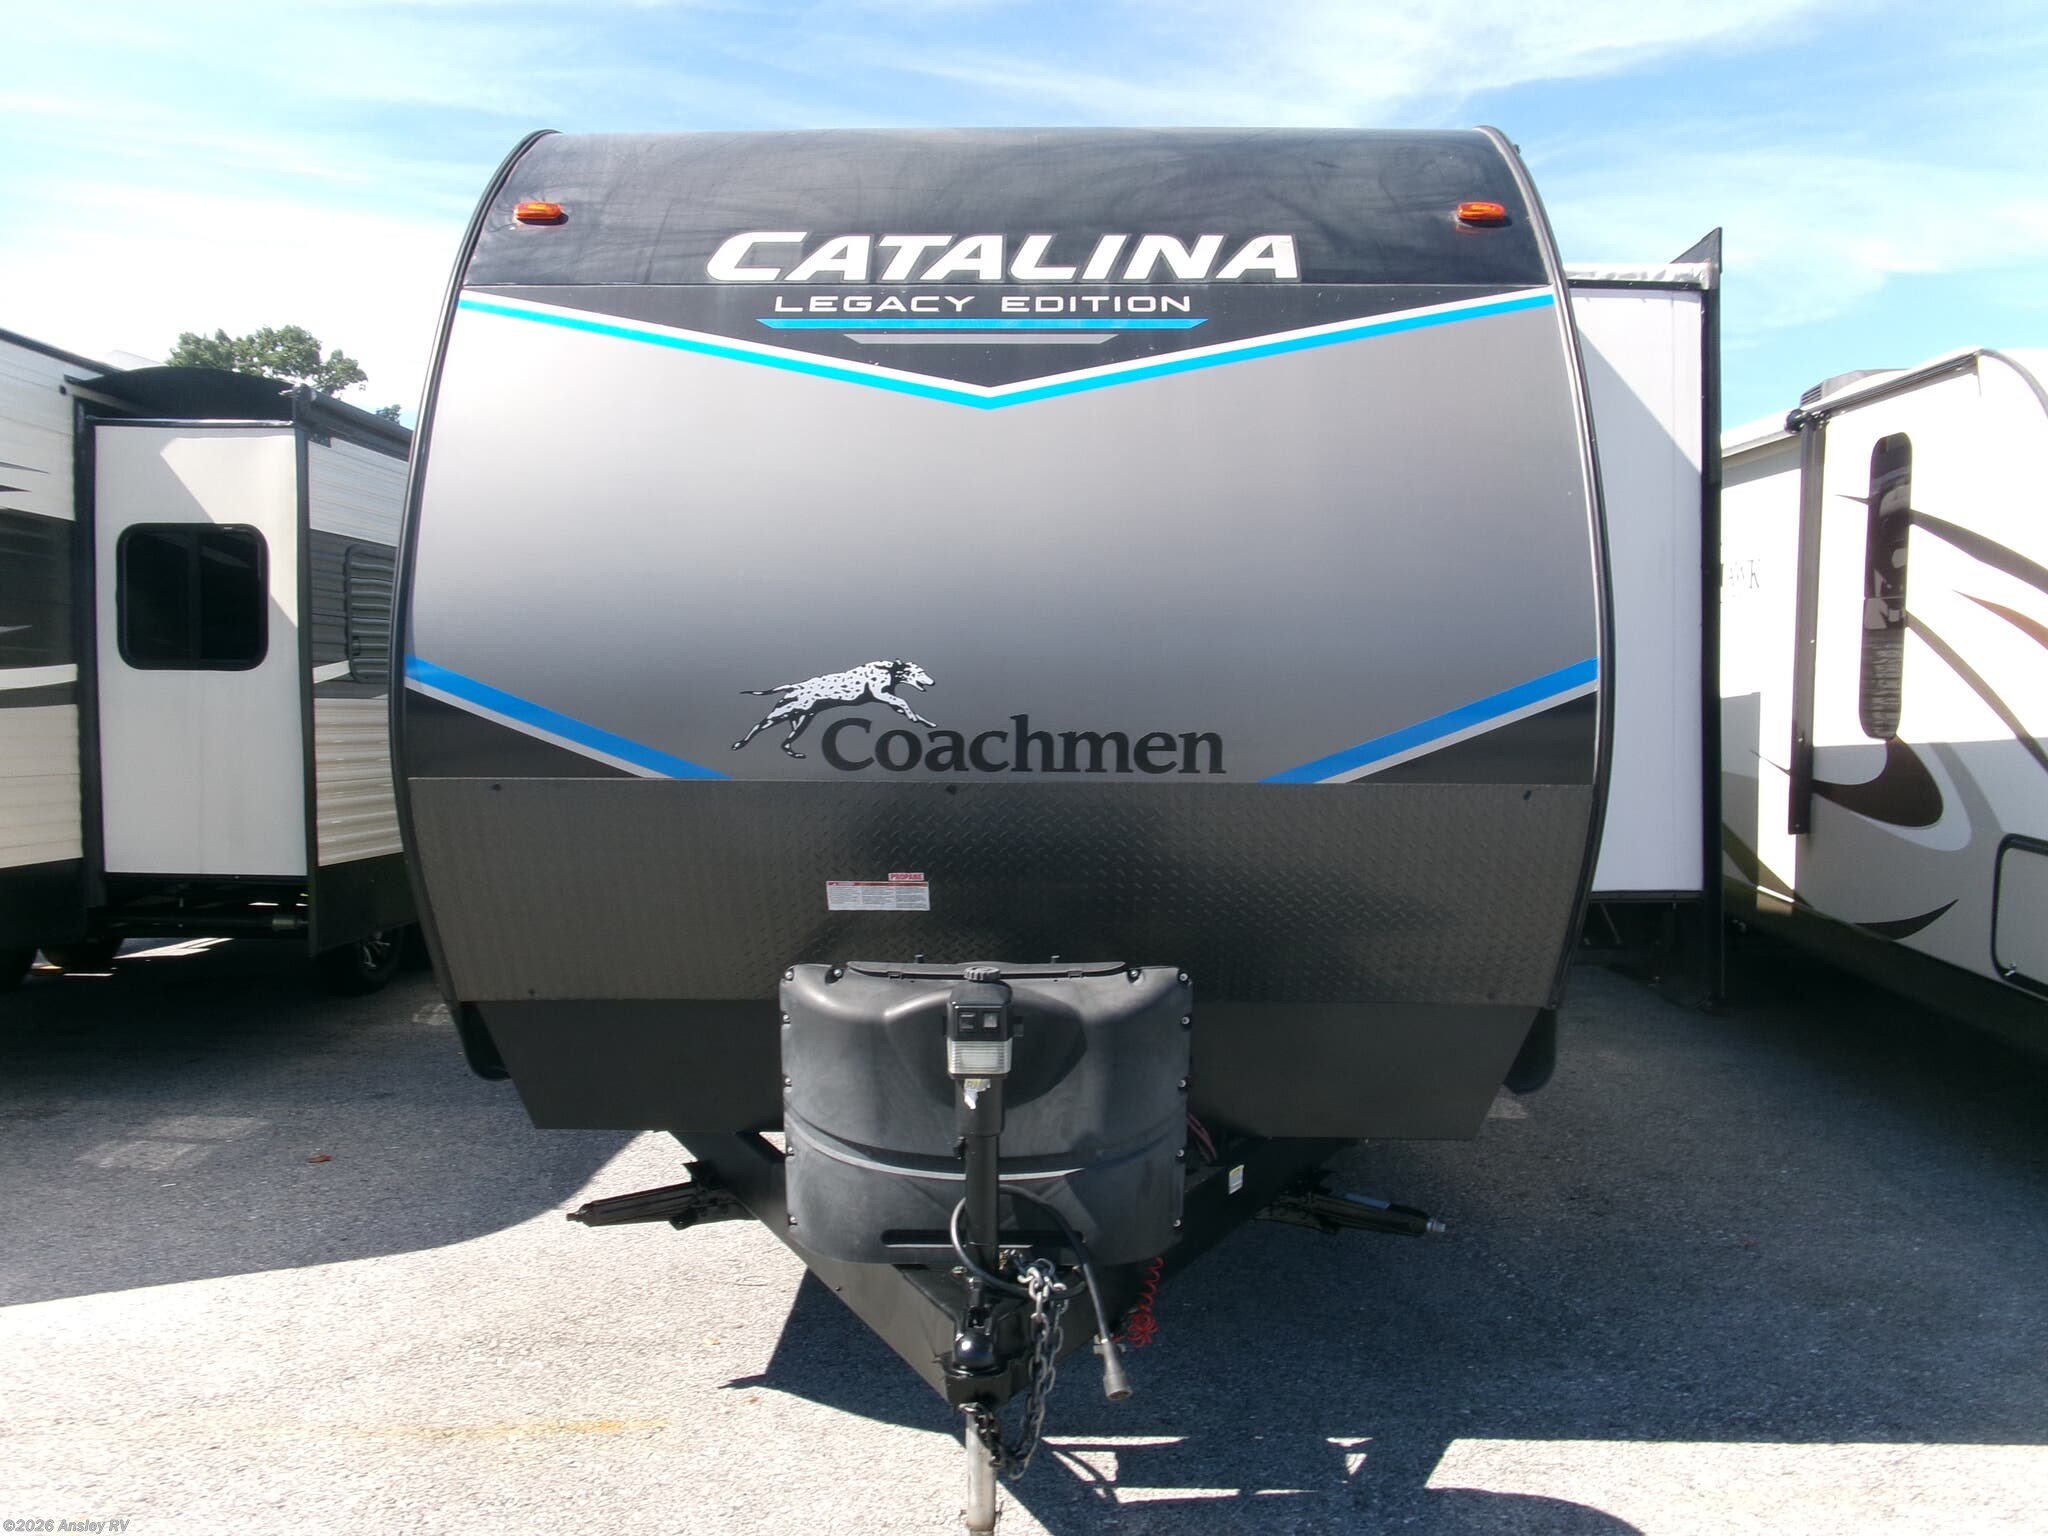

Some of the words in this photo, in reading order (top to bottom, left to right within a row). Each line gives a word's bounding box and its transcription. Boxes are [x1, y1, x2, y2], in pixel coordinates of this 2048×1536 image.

[706, 231, 1300, 281] CATALINA
[774, 295, 975, 313] LEGACY
[1001, 295, 1191, 313] EDITION
[821, 713, 1227, 775] Coachmen
